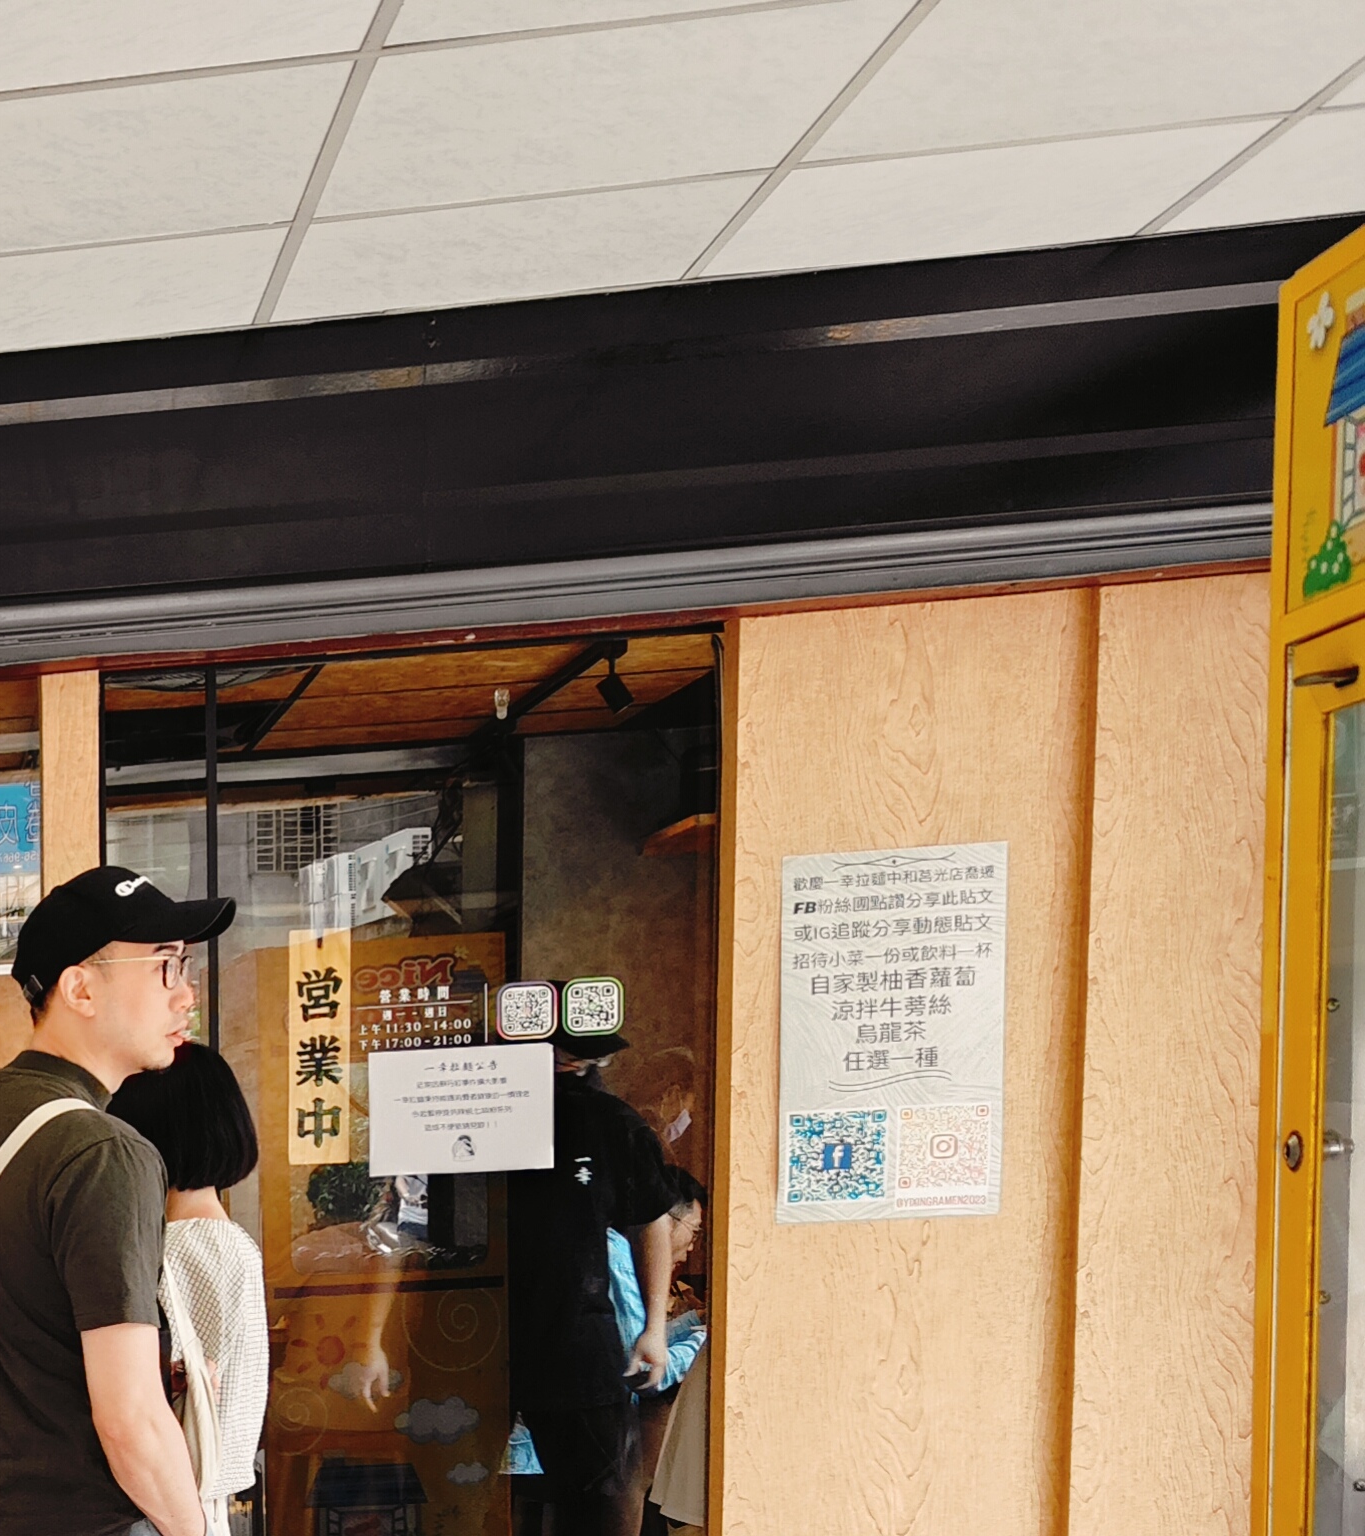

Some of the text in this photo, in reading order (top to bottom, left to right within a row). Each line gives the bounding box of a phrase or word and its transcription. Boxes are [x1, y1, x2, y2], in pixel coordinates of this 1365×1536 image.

[794, 914, 993, 942] 或IG追蹤分享動態貼文
[792, 942, 993, 970] 招待小菜一份或飲料一杯
[811, 966, 976, 995] 自家製柚香蘿蔔
[379, 985, 449, 1004] 營業時間
[831, 994, 952, 1021] 涼拌牛蒡絲
[855, 1021, 926, 1044] 烏龍茶
[296, 967, 343, 1148] 営業中
[843, 1046, 938, 1072] 任選一種
